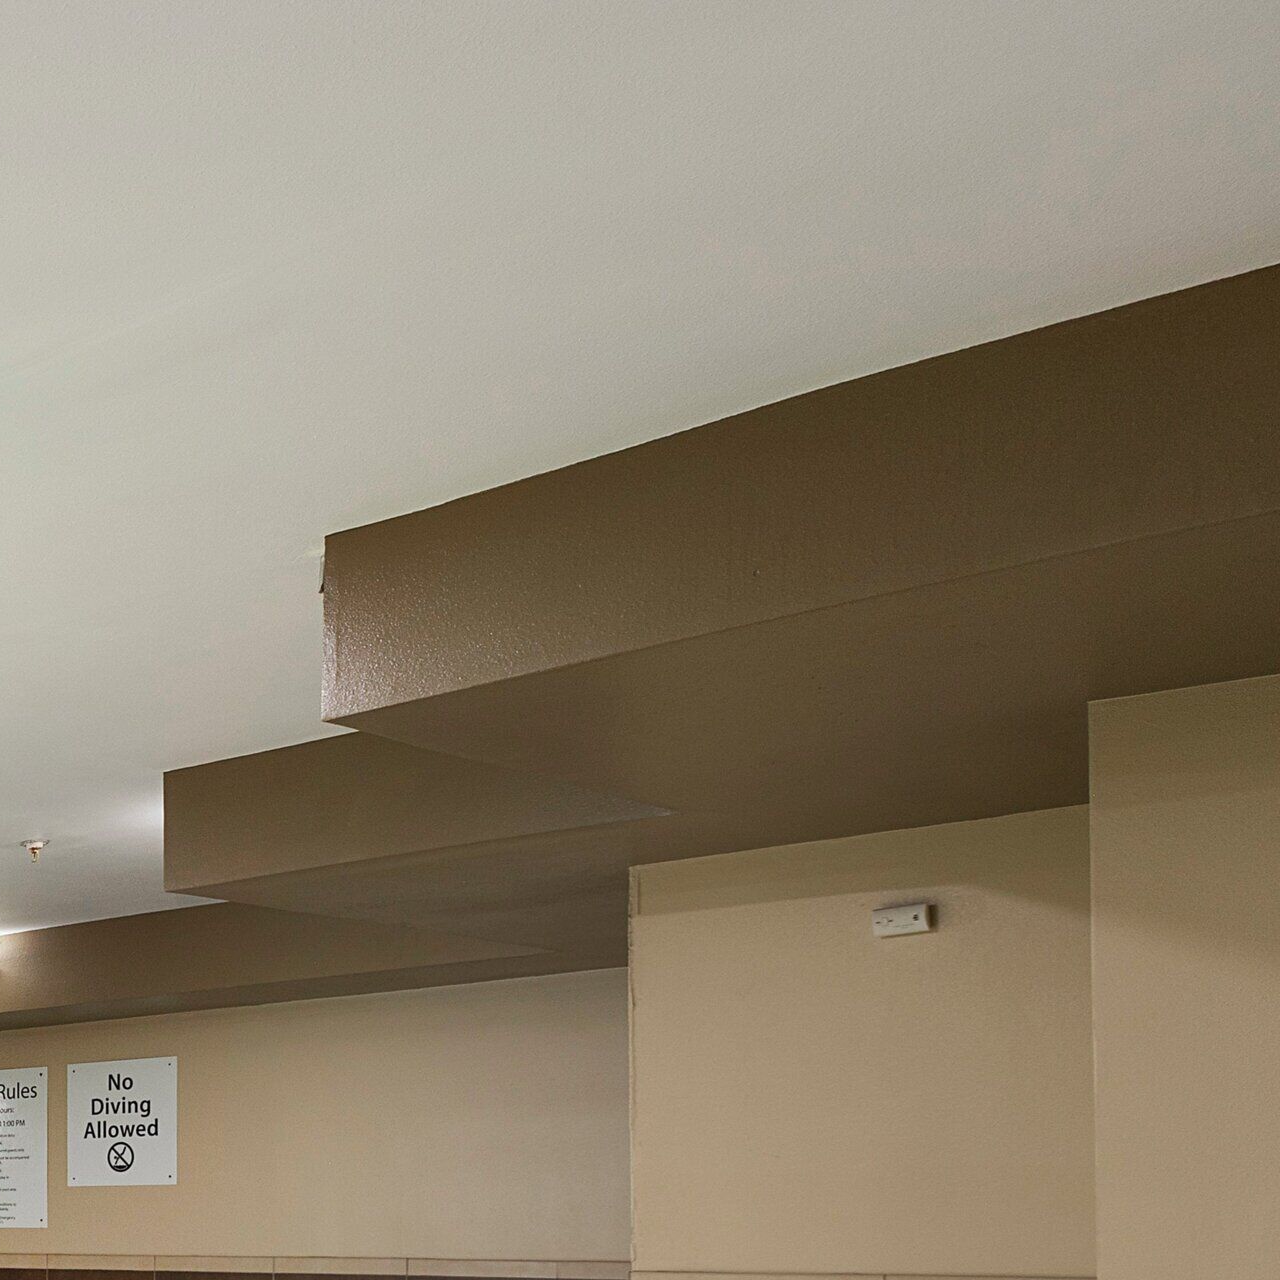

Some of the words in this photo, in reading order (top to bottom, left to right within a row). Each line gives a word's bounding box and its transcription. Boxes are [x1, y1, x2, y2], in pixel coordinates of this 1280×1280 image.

[108, 1073, 134, 1091] No
[91, 1096, 151, 1118] Diving
[15, 1119, 26, 1127] PM
[83, 1118, 159, 1139] Allowed
